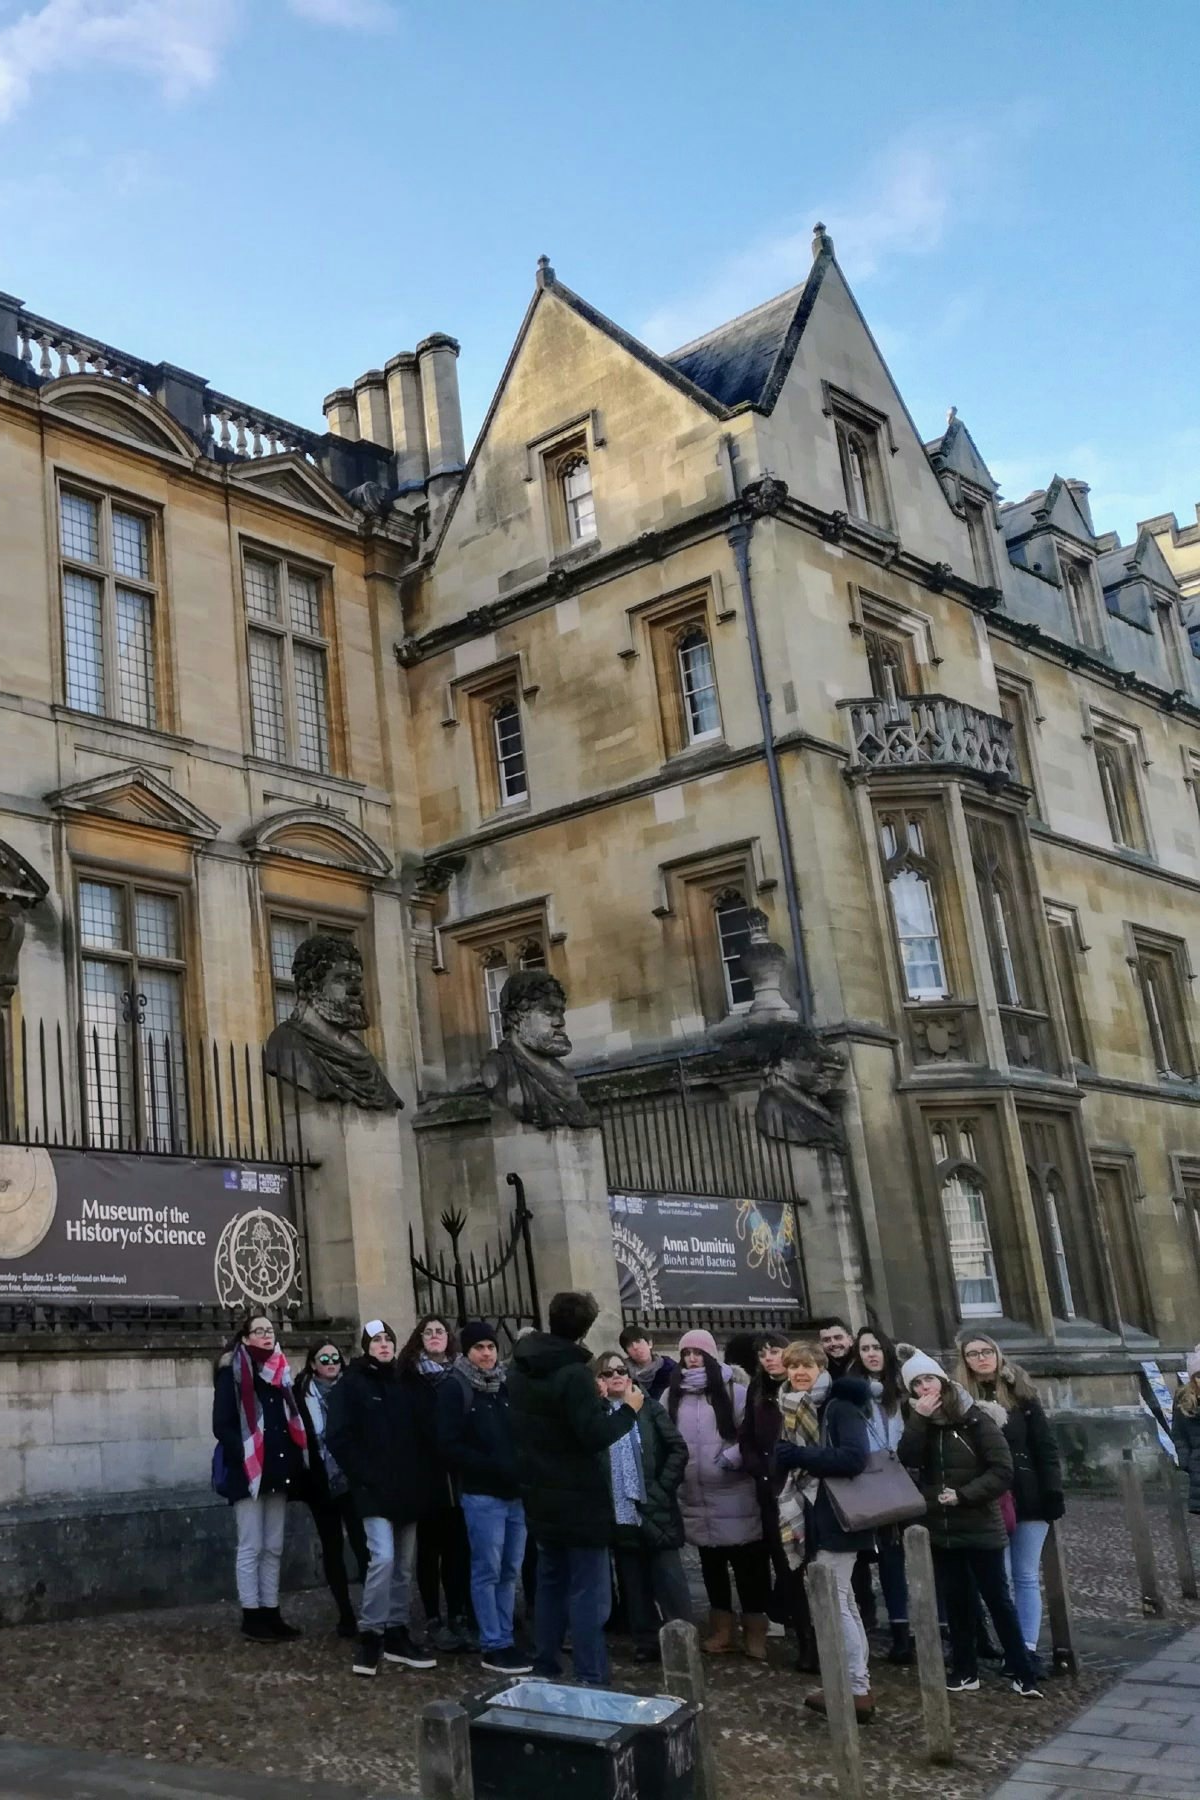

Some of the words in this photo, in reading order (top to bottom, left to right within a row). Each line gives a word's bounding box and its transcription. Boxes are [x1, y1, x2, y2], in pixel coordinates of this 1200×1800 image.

[82, 1199, 153, 1222] Museum
[155, 1206, 168, 1222] of
[170, 1206, 189, 1224] the
[66, 1219, 129, 1249] History
[129, 1227, 142, 1243] of
[144, 1223, 206, 1245] Science
[664, 1235, 689, 1252] Anna
[690, 1237, 735, 1254] Dumitriu
[663, 1253, 688, 1265] BioArt
[690, 1255, 704, 1266] and
[706, 1256, 736, 1268] Bacteria
[45, 1273, 53, 1282] 12
[71, 1273, 92, 1283] (closed
[100, 1274, 127, 1284] Mondays)
[22, 1283, 51, 1292] donations
